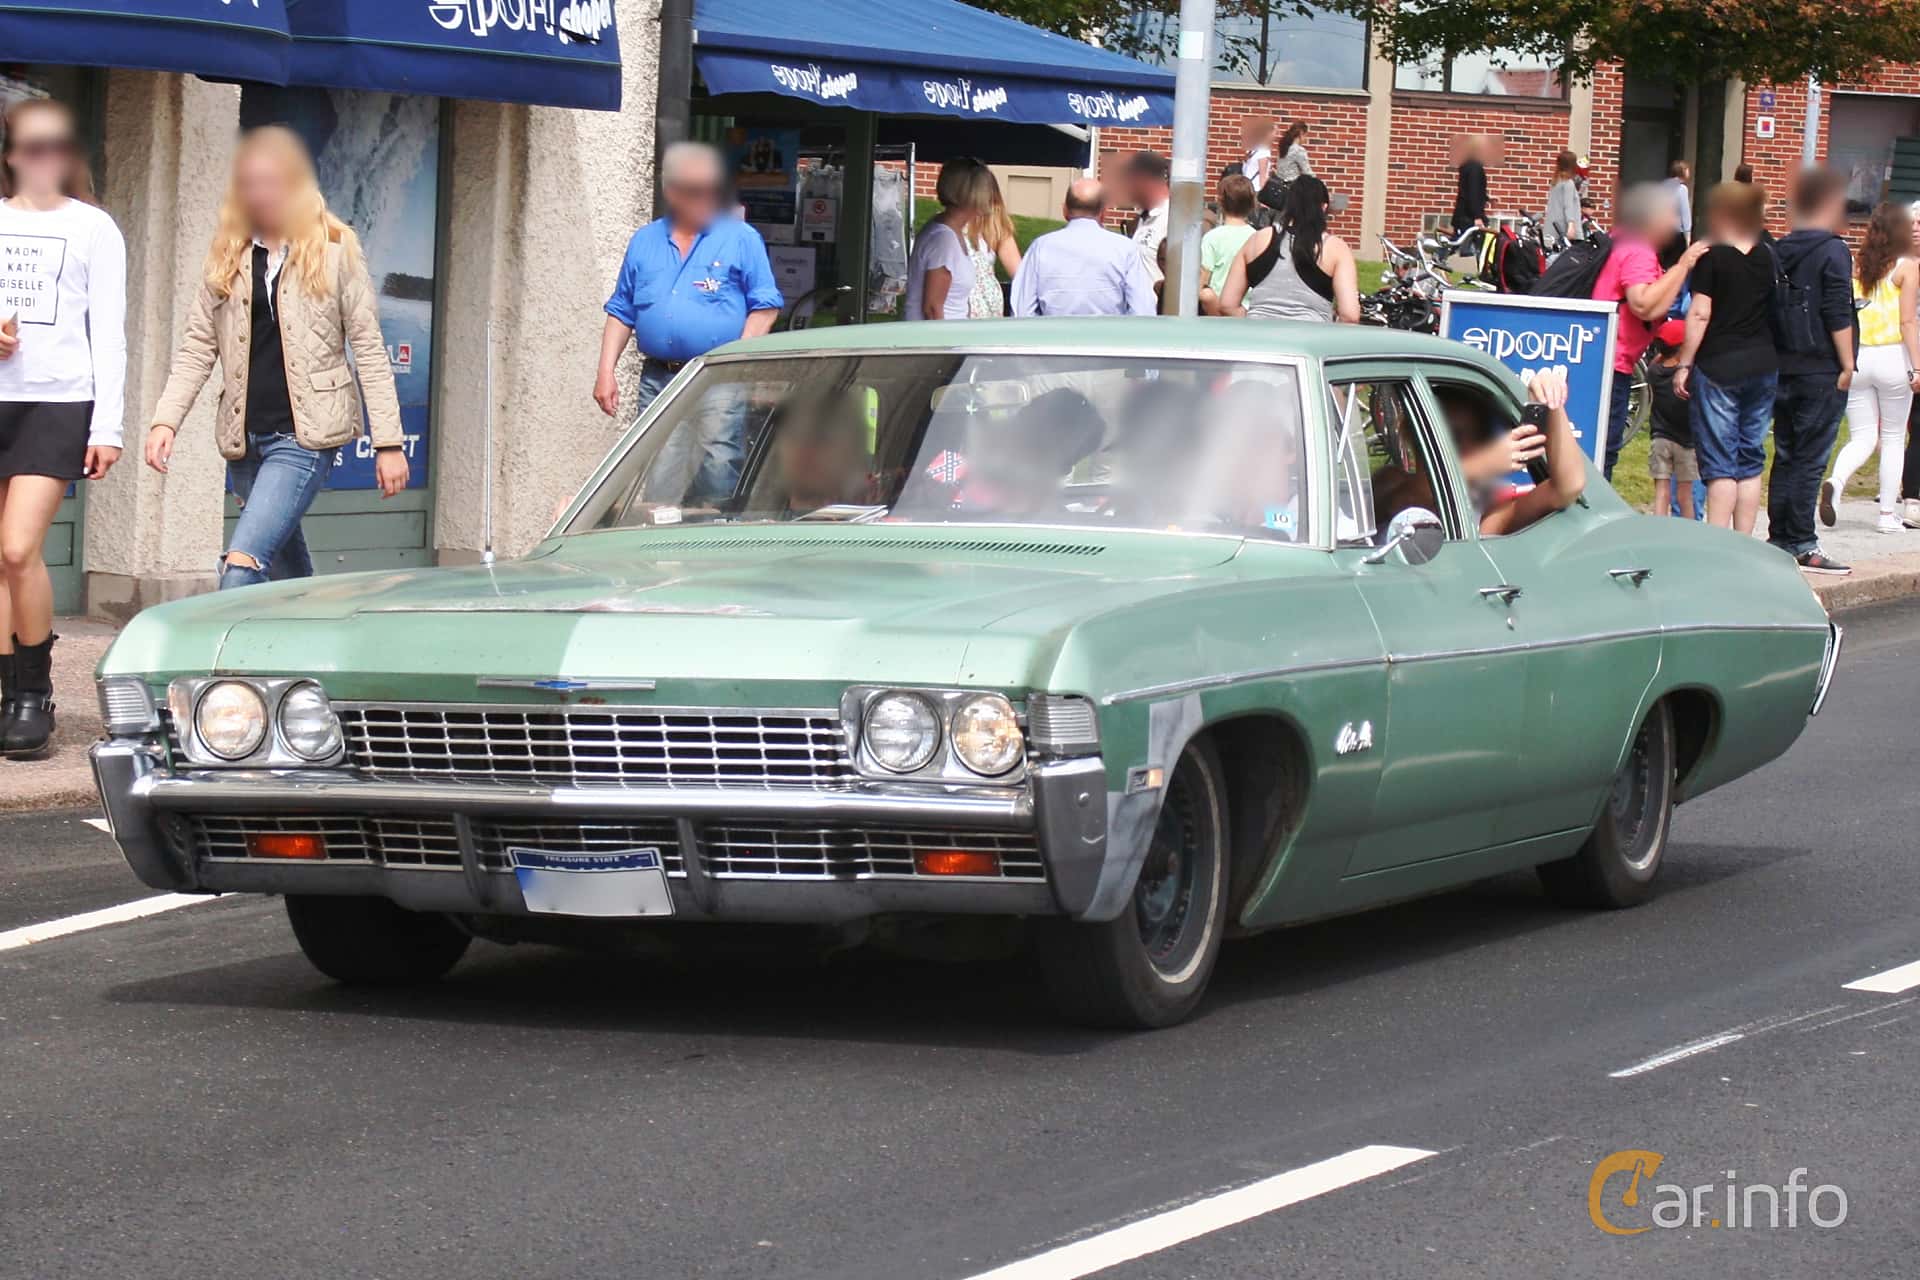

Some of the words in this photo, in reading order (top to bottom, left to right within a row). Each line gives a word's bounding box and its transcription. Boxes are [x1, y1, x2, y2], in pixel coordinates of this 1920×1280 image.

[5, 247, 43, 257] NAOMI
[7, 263, 38, 273] KATE
[0, 278, 44, 291] GISELLE
[6, 296, 36, 308] HEIDI
